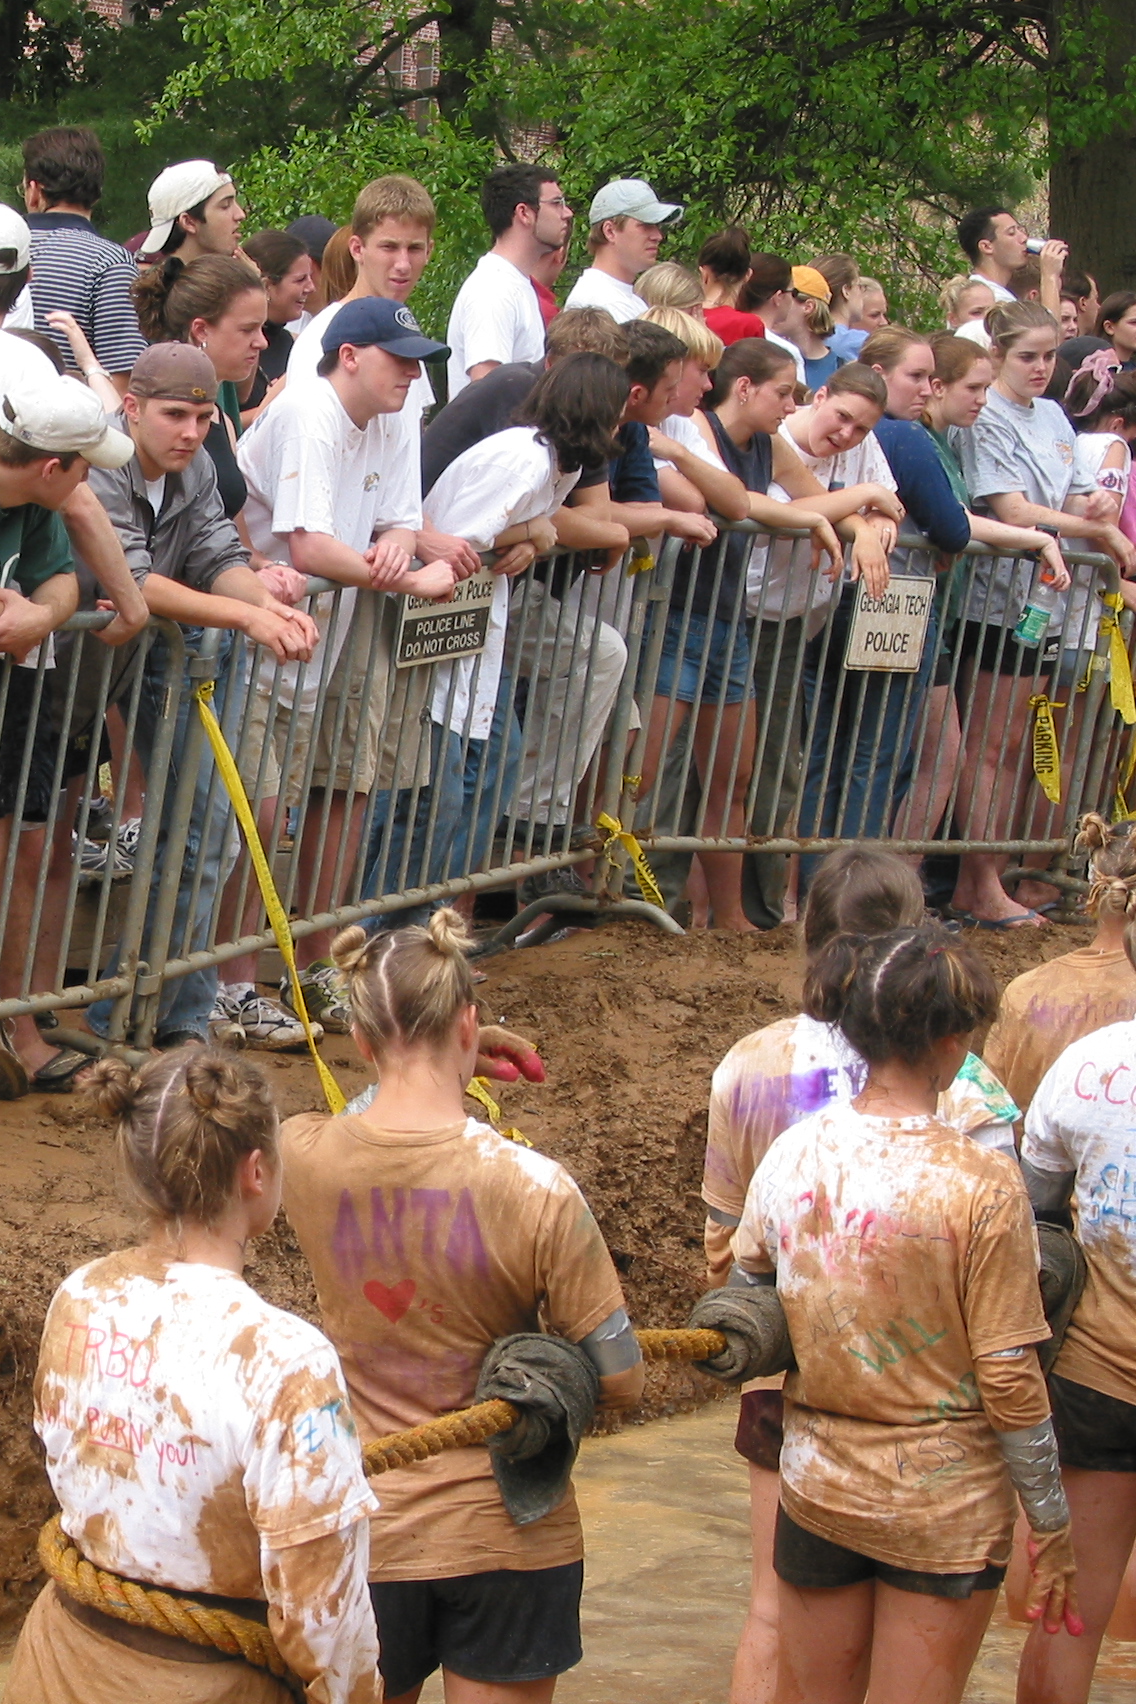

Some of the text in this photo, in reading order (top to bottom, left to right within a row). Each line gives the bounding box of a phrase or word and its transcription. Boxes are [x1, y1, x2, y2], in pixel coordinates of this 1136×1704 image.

[466, 580, 493, 600] POLICE
[860, 591, 928, 616] GEORGIA TECH
[416, 613, 476, 637] POLICE LINE
[405, 631, 481, 658] DO NOT CROSS
[864, 631, 910, 654] POLICE
[1035, 715, 1054, 775] PARKING
[848, 1317, 948, 1374] WILL
[86, 1406, 145, 1454] BURN
[894, 1424, 967, 1480] ASS
